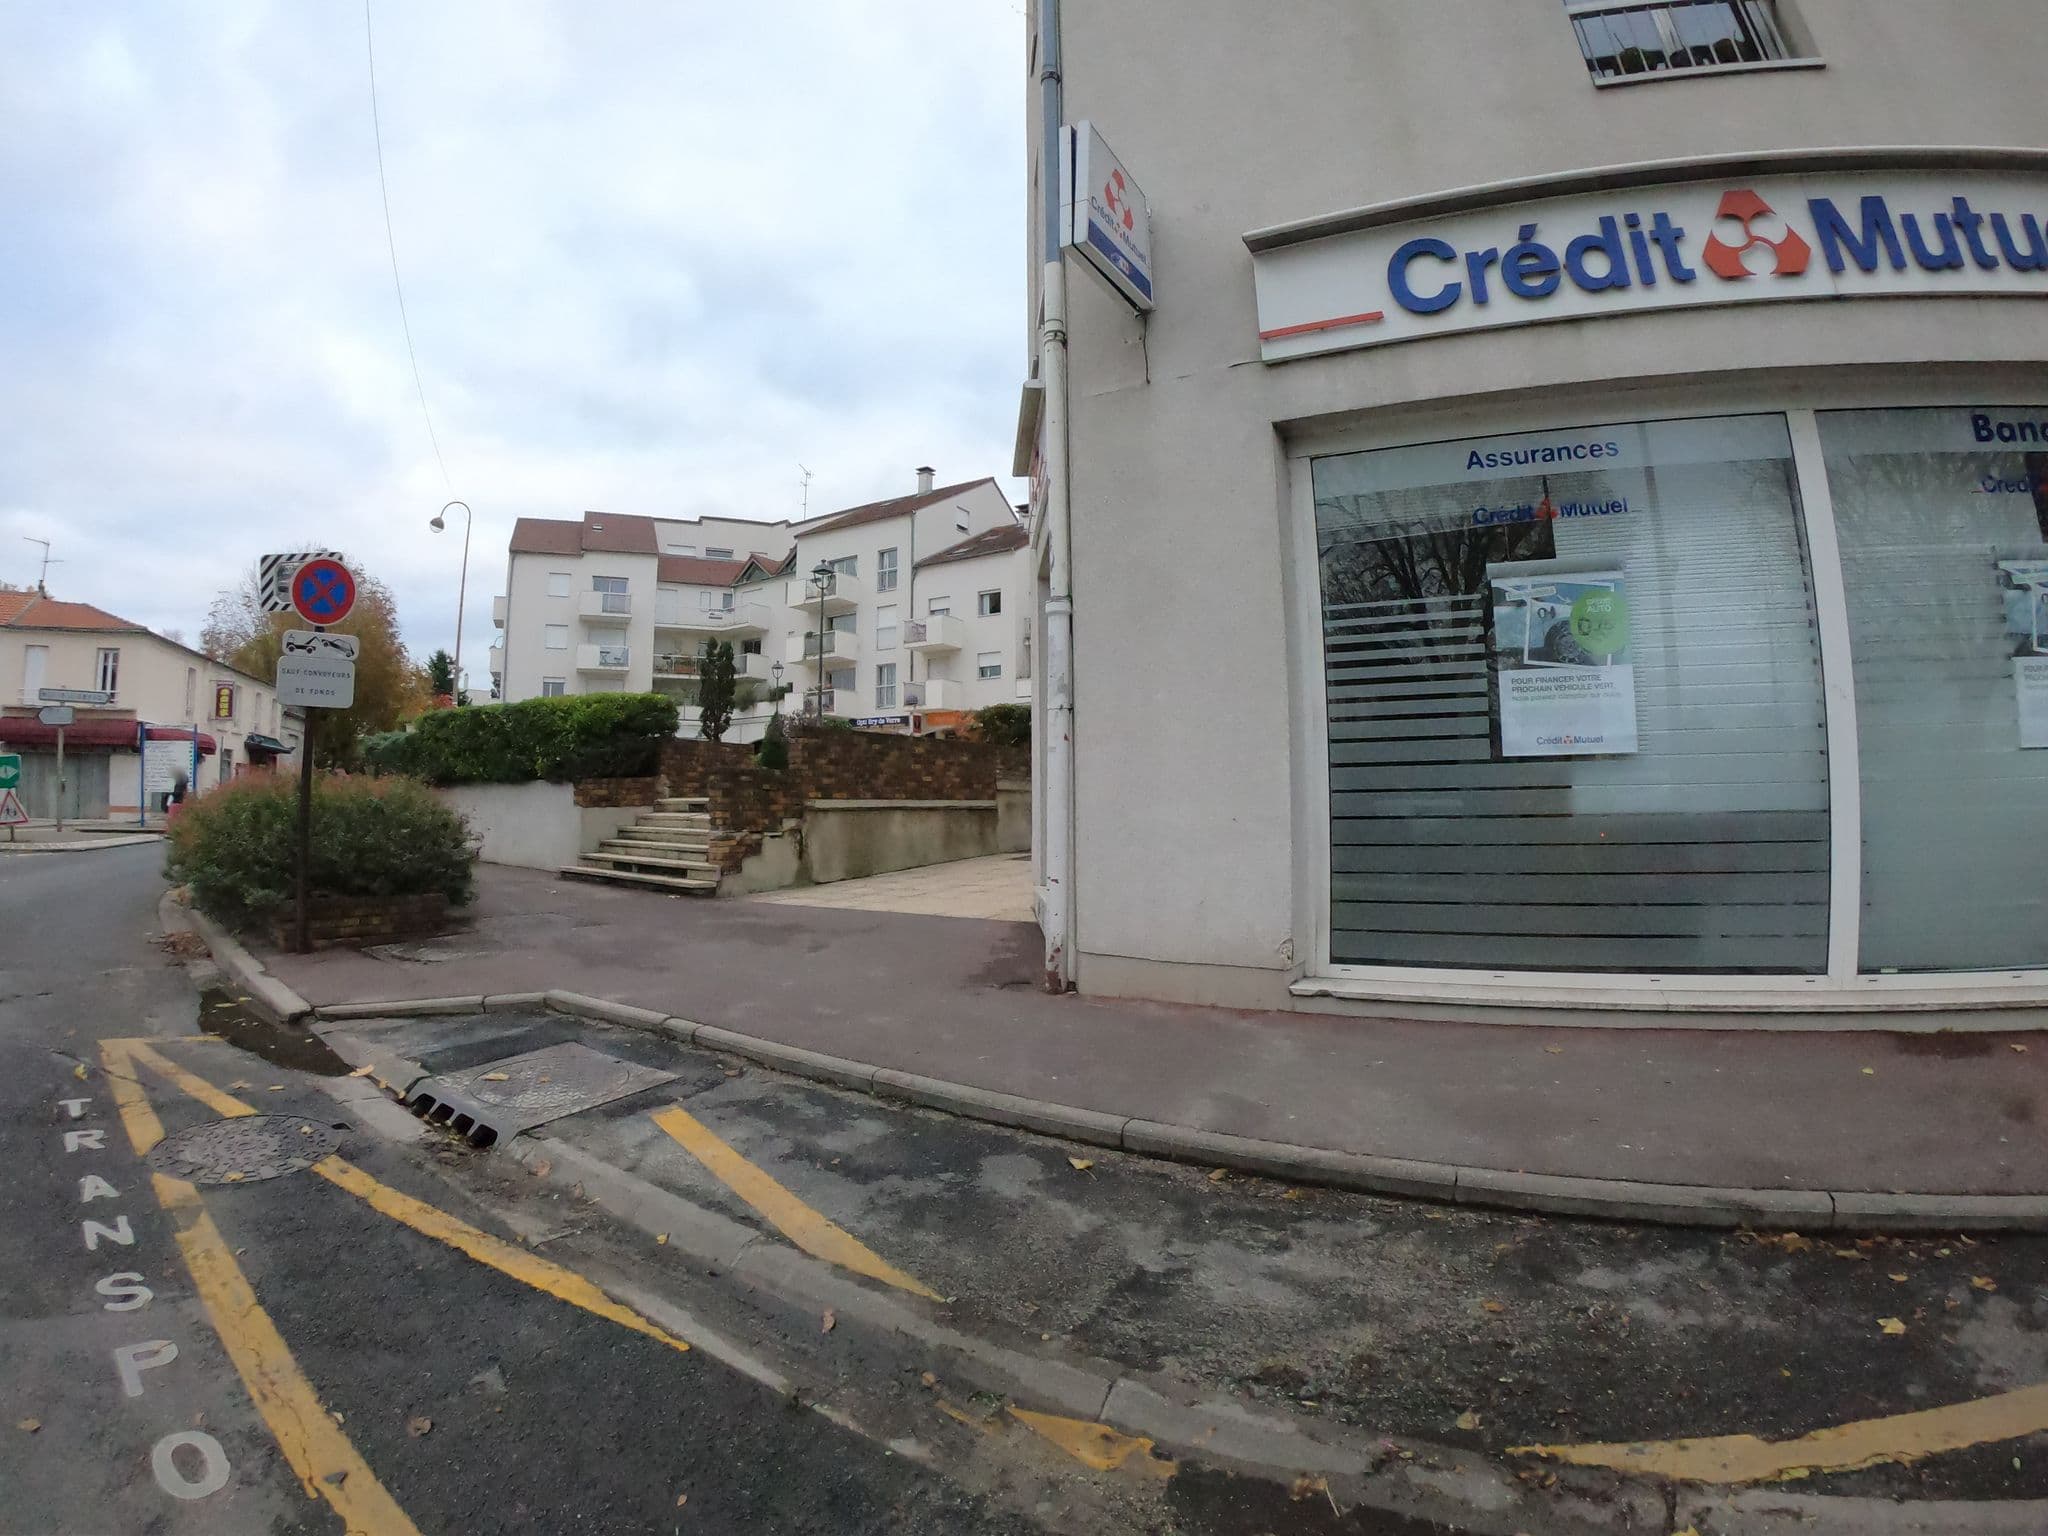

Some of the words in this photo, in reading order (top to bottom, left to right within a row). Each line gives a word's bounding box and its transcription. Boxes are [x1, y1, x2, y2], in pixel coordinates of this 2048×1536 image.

[1387, 211, 1697, 313] Crédit
[1808, 196, 2048, 273] Mutu
[1466, 441, 1619, 470] Assurances
[1561, 497, 1628, 518] Mutuel
[1536, 675, 1574, 684] FINANCER
[1573, 735, 1604, 744] Mutuel
